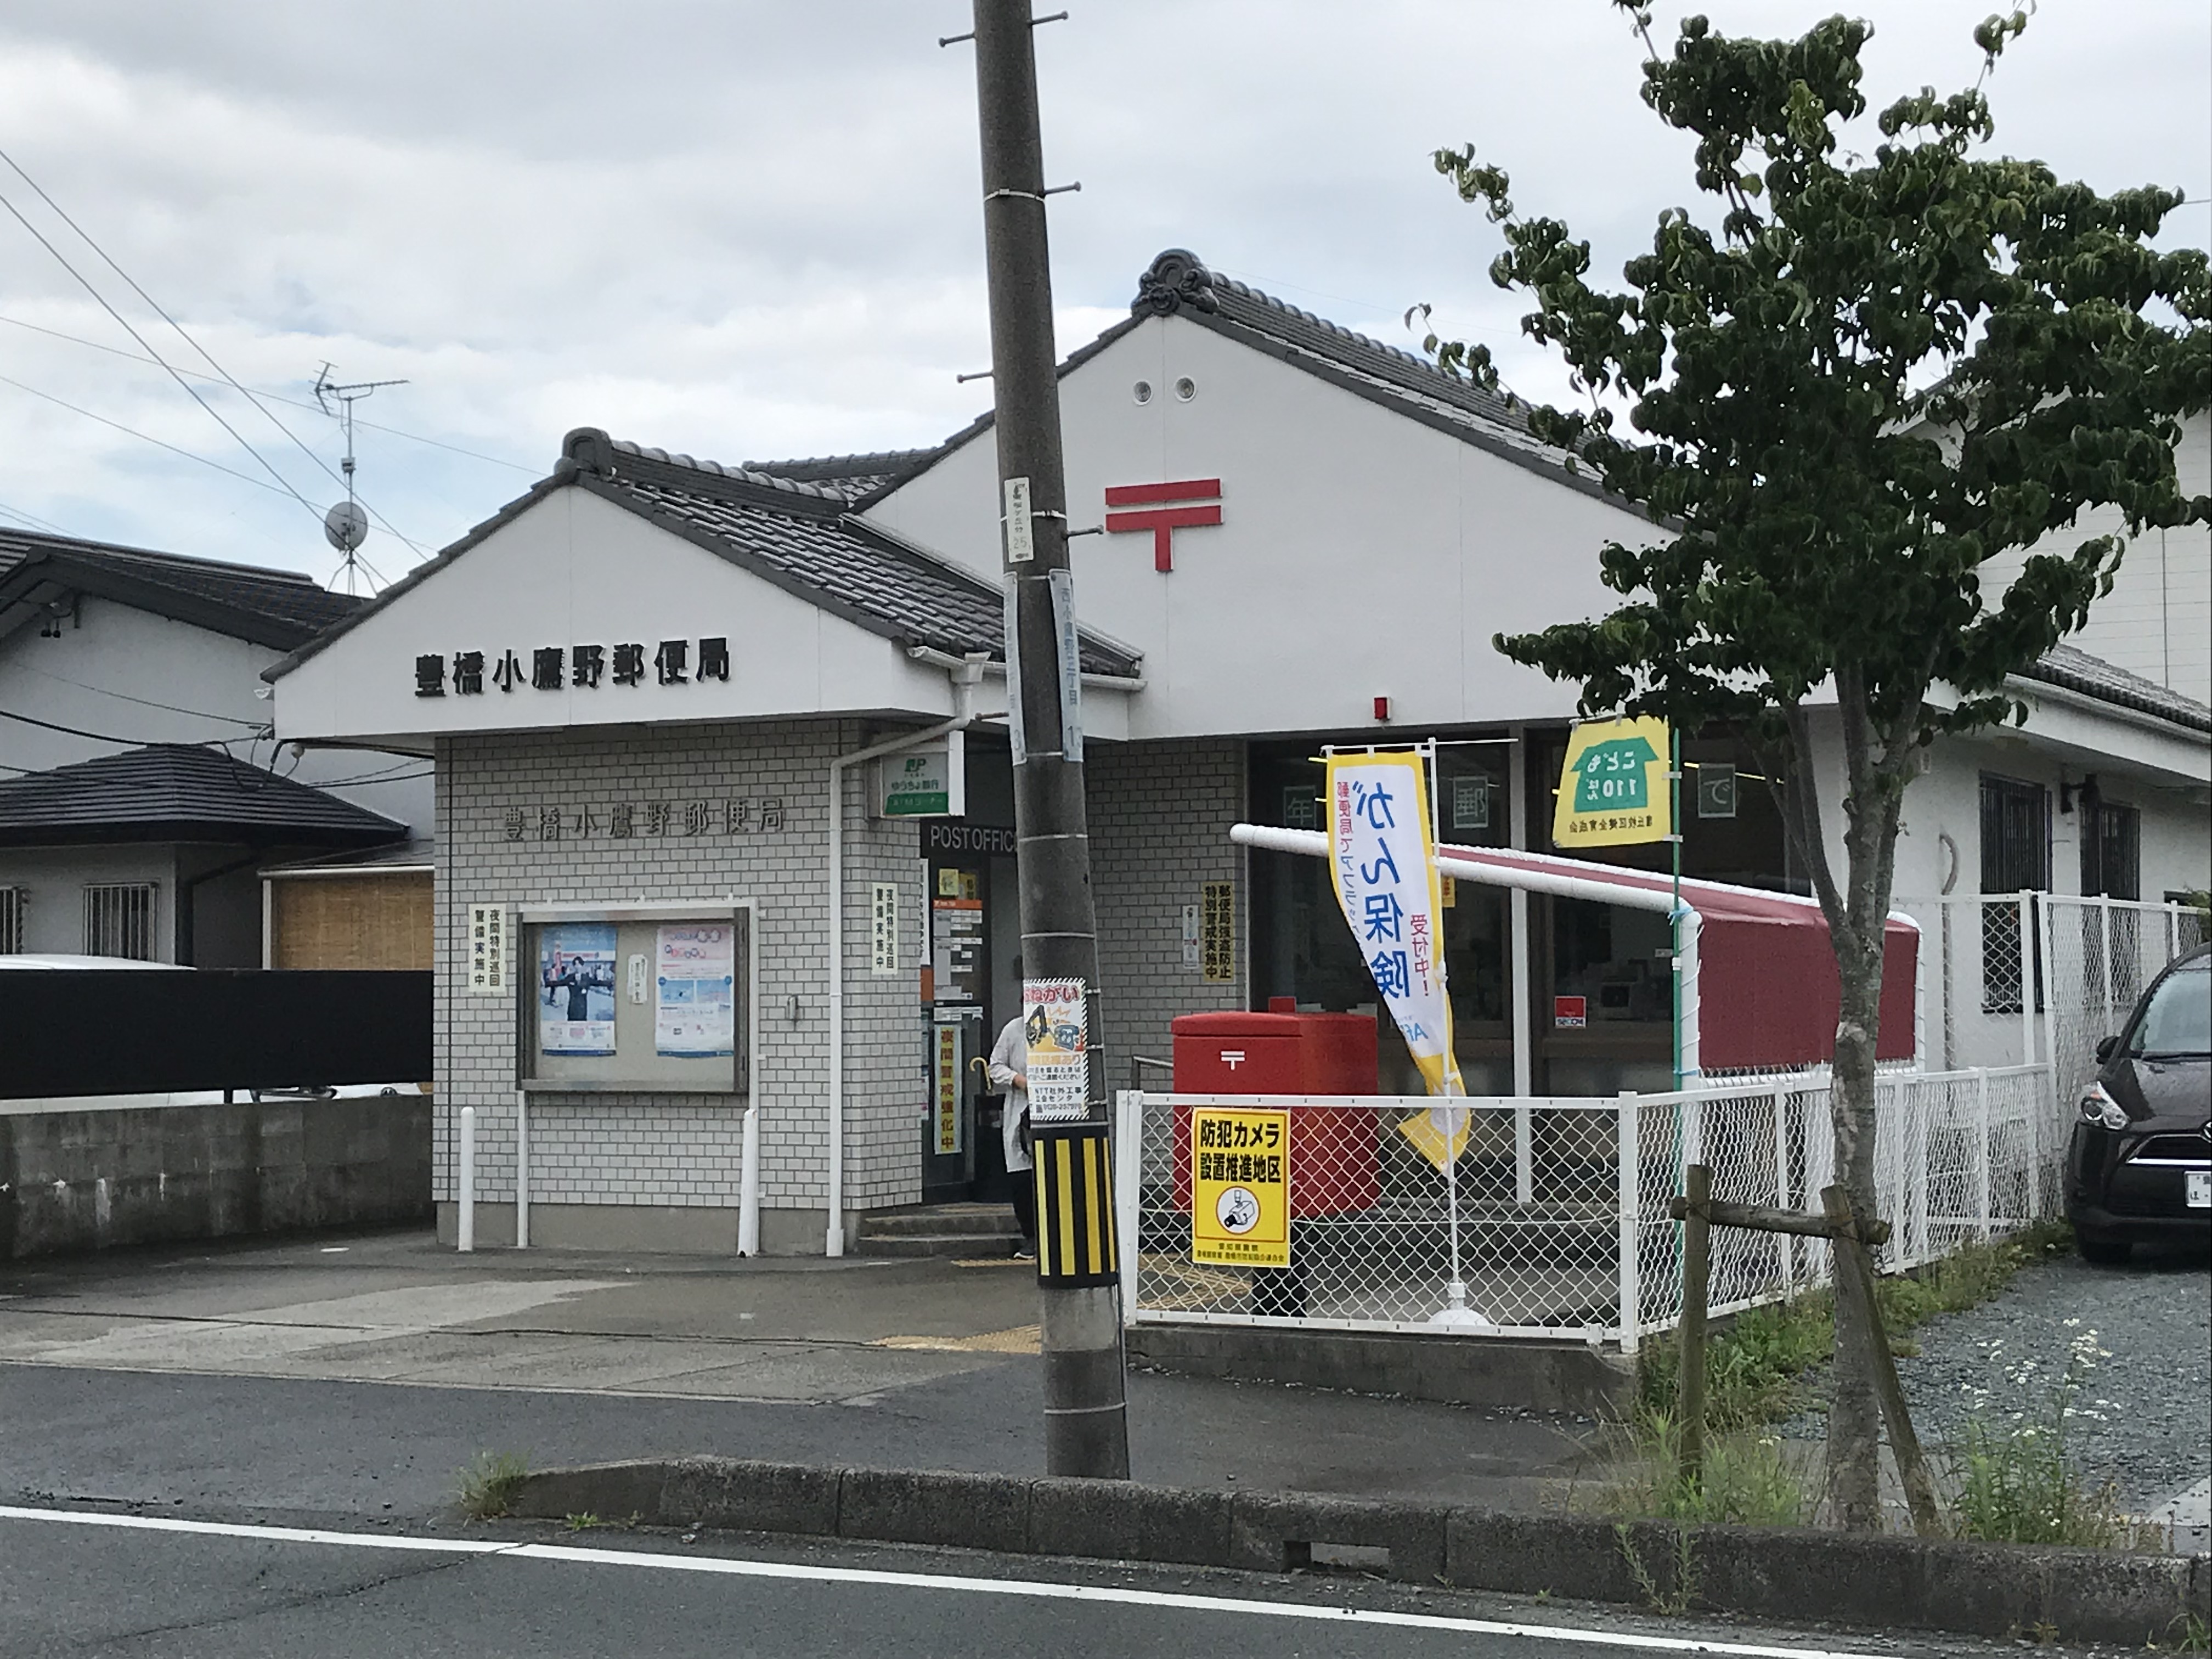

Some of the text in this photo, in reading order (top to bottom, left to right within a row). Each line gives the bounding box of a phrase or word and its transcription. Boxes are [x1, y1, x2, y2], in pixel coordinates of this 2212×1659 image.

[415, 637, 731, 697] 豊橋小鷹野郵便局
[503, 798, 786, 843] 豊橋小鷹野郵便局
[930, 825, 1015, 853] POST OFFIC
[1200, 1119, 1280, 1148] 防犯カメラ
[1200, 1153, 1282, 1183] 設置推進地区
